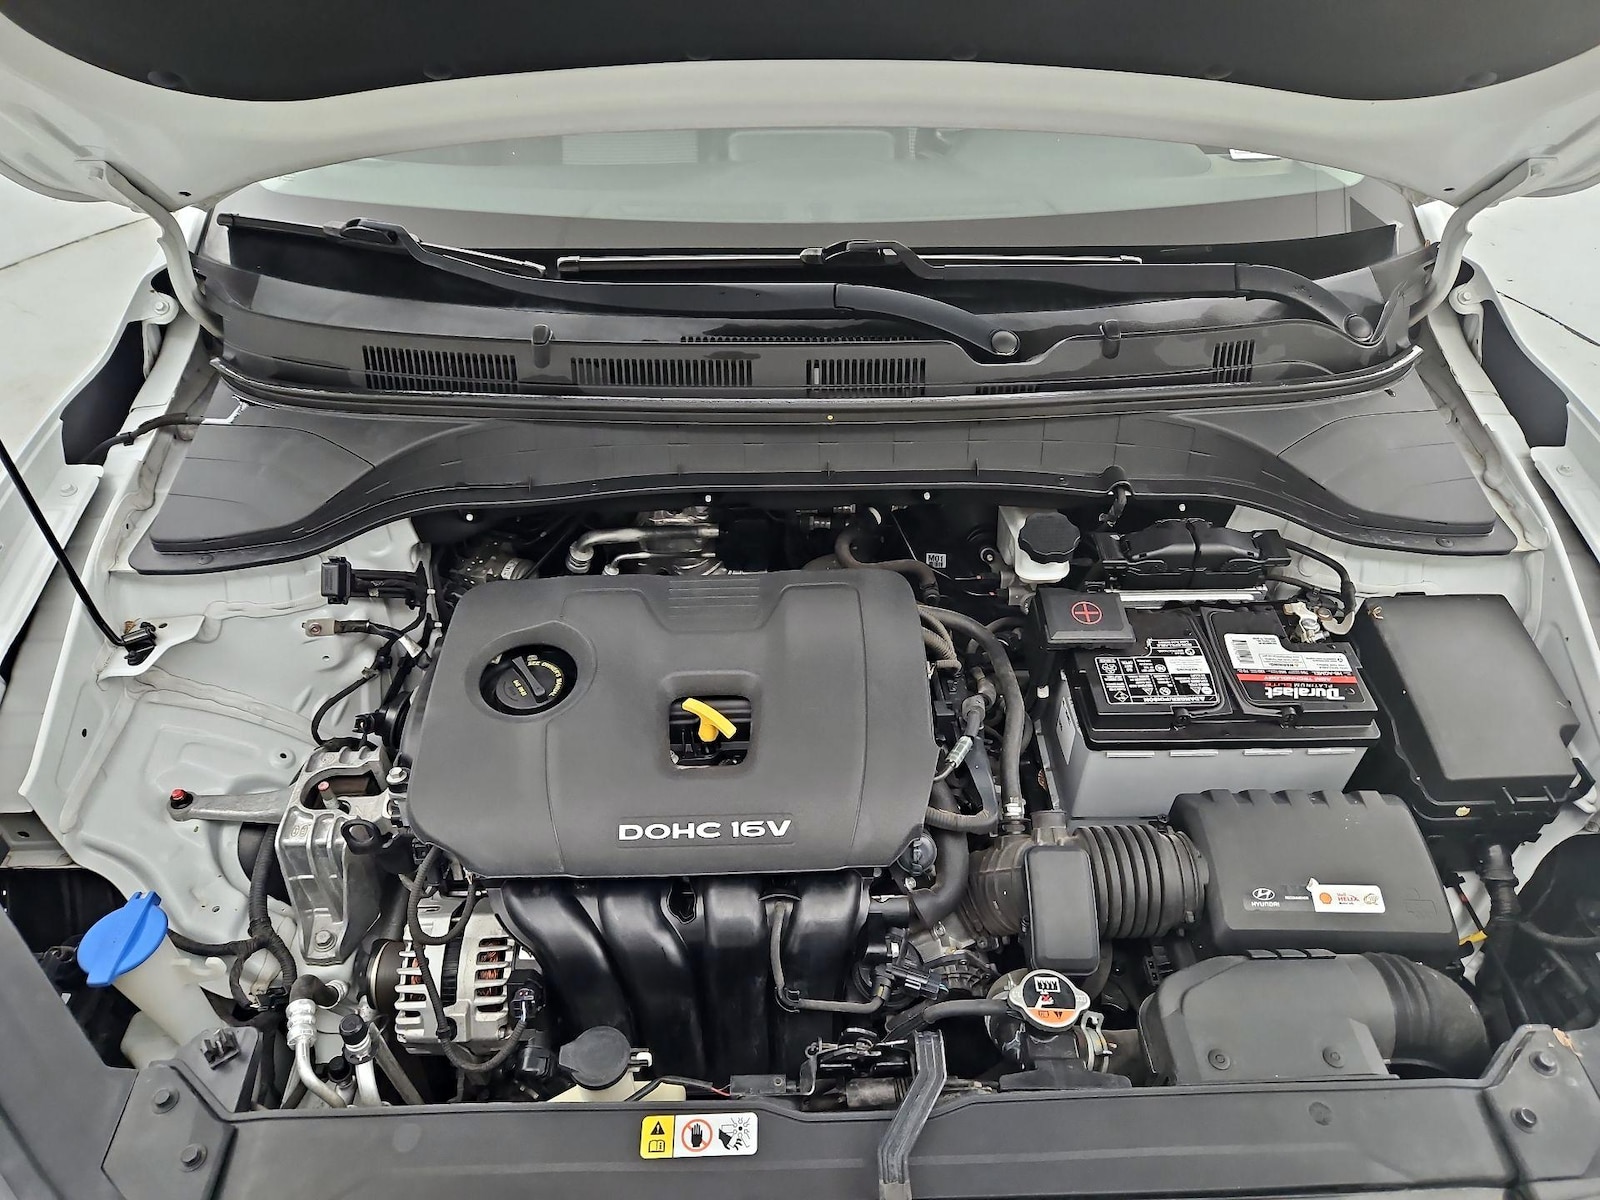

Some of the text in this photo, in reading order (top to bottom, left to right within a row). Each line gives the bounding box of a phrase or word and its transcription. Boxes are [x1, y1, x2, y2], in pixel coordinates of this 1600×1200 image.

[1265, 686, 1345, 700] Duralast
[618, 819, 792, 841] DOHC 16V
